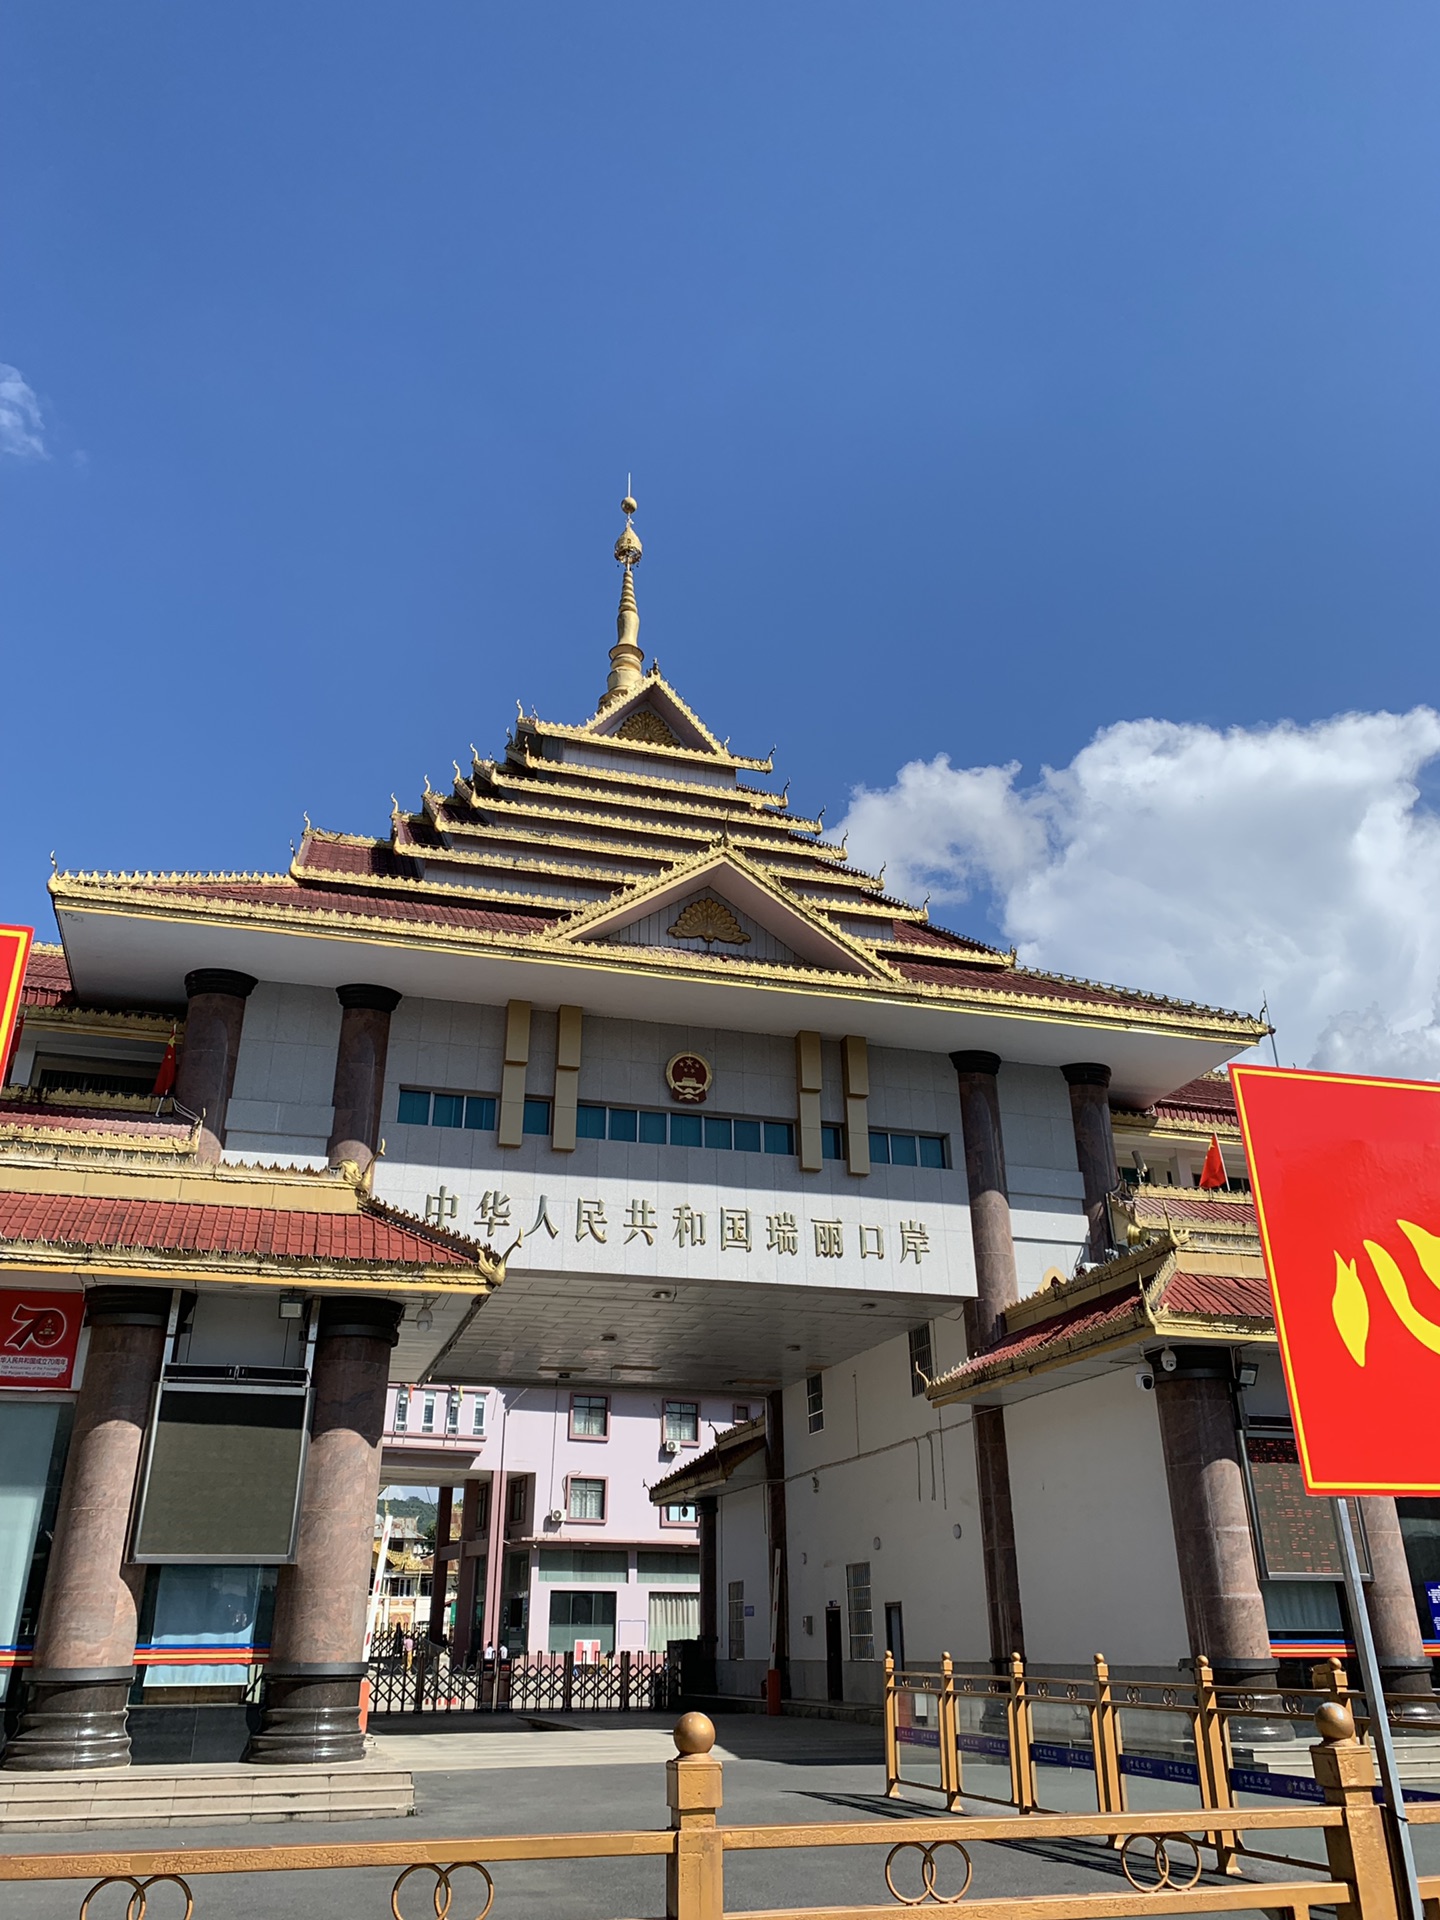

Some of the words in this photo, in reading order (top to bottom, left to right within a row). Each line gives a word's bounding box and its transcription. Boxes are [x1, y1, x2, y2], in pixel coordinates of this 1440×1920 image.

[425, 1185, 930, 1264] 中华人民共和国瑞丽口岸
